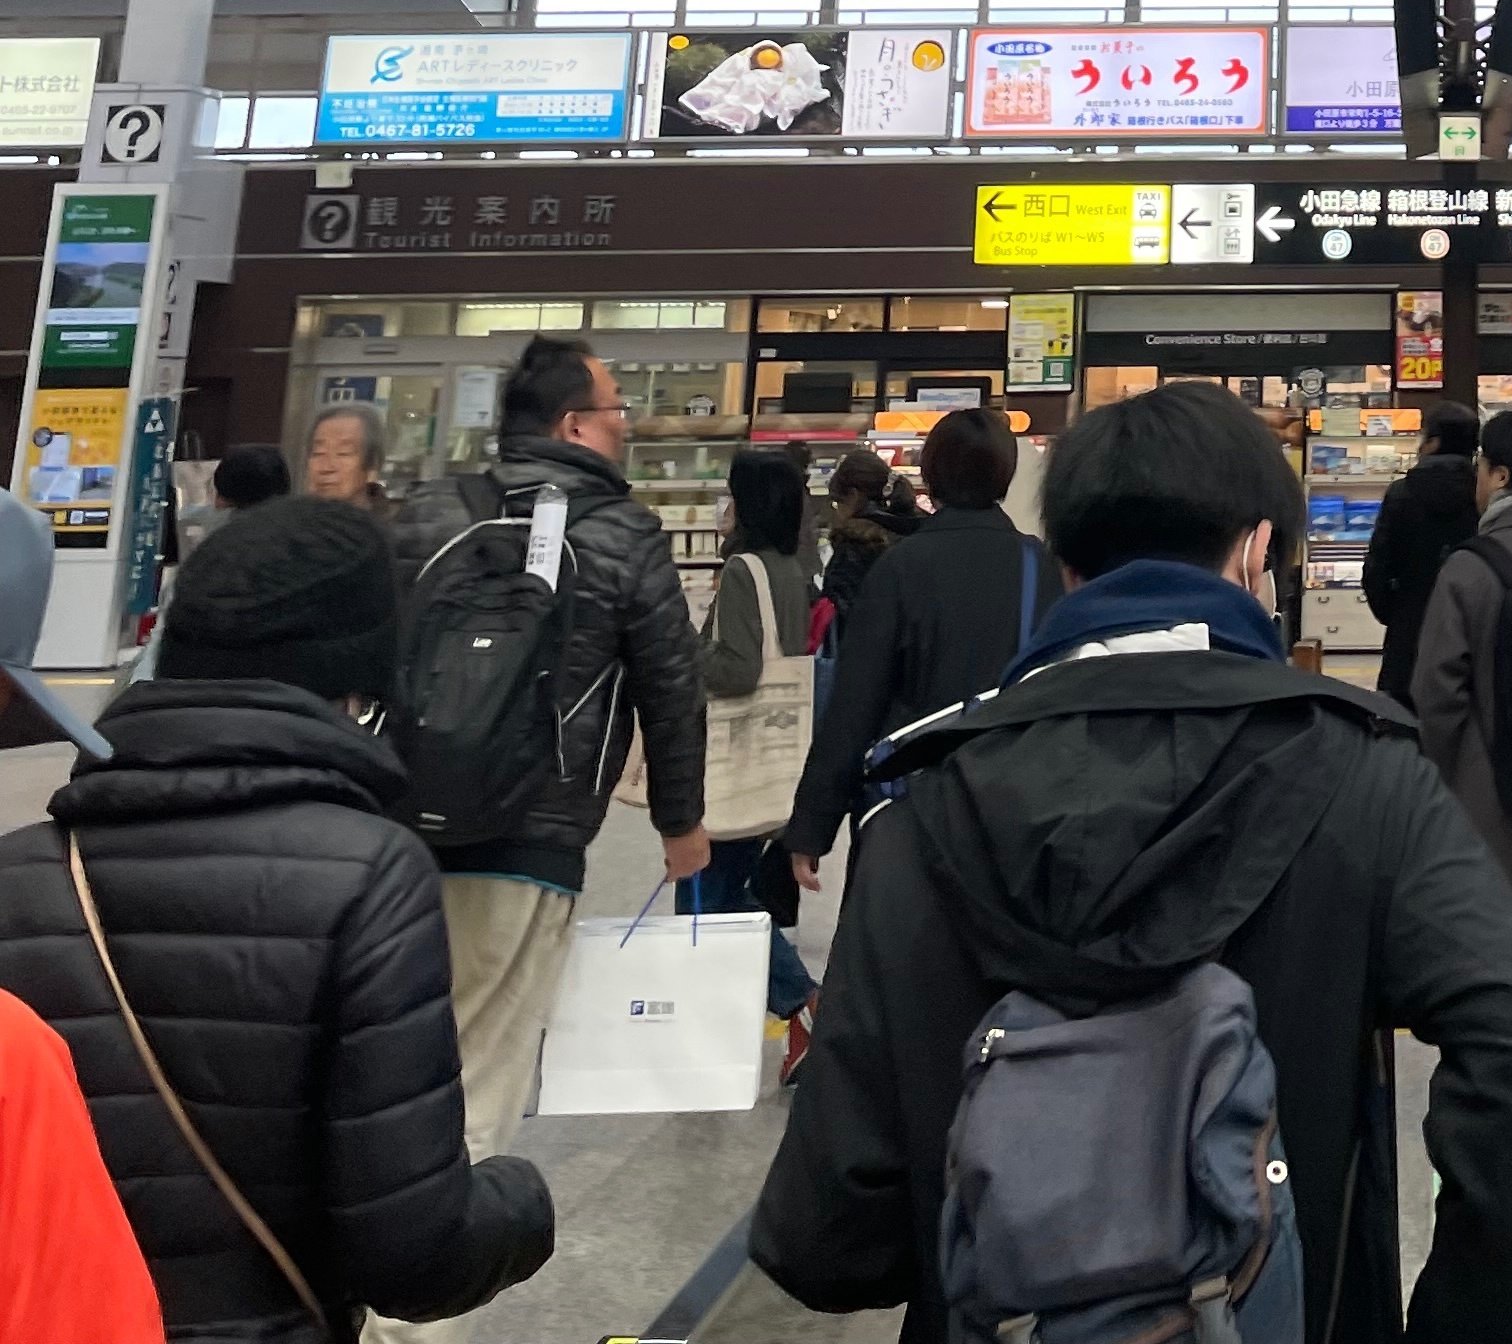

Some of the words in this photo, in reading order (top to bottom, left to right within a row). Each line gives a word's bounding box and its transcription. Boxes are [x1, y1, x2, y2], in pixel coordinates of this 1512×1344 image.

[418, 59, 578, 73] ARTレディースクリニック
[1071, 58, 1249, 96] ういろう
[1136, 192, 1161, 201] TAXI
[1300, 190, 1381, 213] 小田急線
[1387, 190, 1489, 212] 箱根登山線
[366, 195, 617, 226] 観光案内所
[1023, 194, 1070, 218] 西口
[1075, 204, 1104, 215] West
[1106, 204, 1127, 215] Exit
[1312, 214, 1351, 228] Odakyu
[1352, 214, 1377, 226] Line
[1387, 214, 1455, 226] Hakonetozan
[1457, 214, 1480, 226] Line
[364, 232, 451, 248] Tourist
[470, 232, 611, 247] Information
[990, 232, 1051, 243] バスのりば
[993, 246, 1012, 256] Bus
[1014, 246, 1038, 258] Stop
[1331, 242, 1343, 252] 47
[1428, 242, 1442, 252] 47
[1145, 334, 1221, 344] Convenience
[1223, 334, 1256, 344] Store
